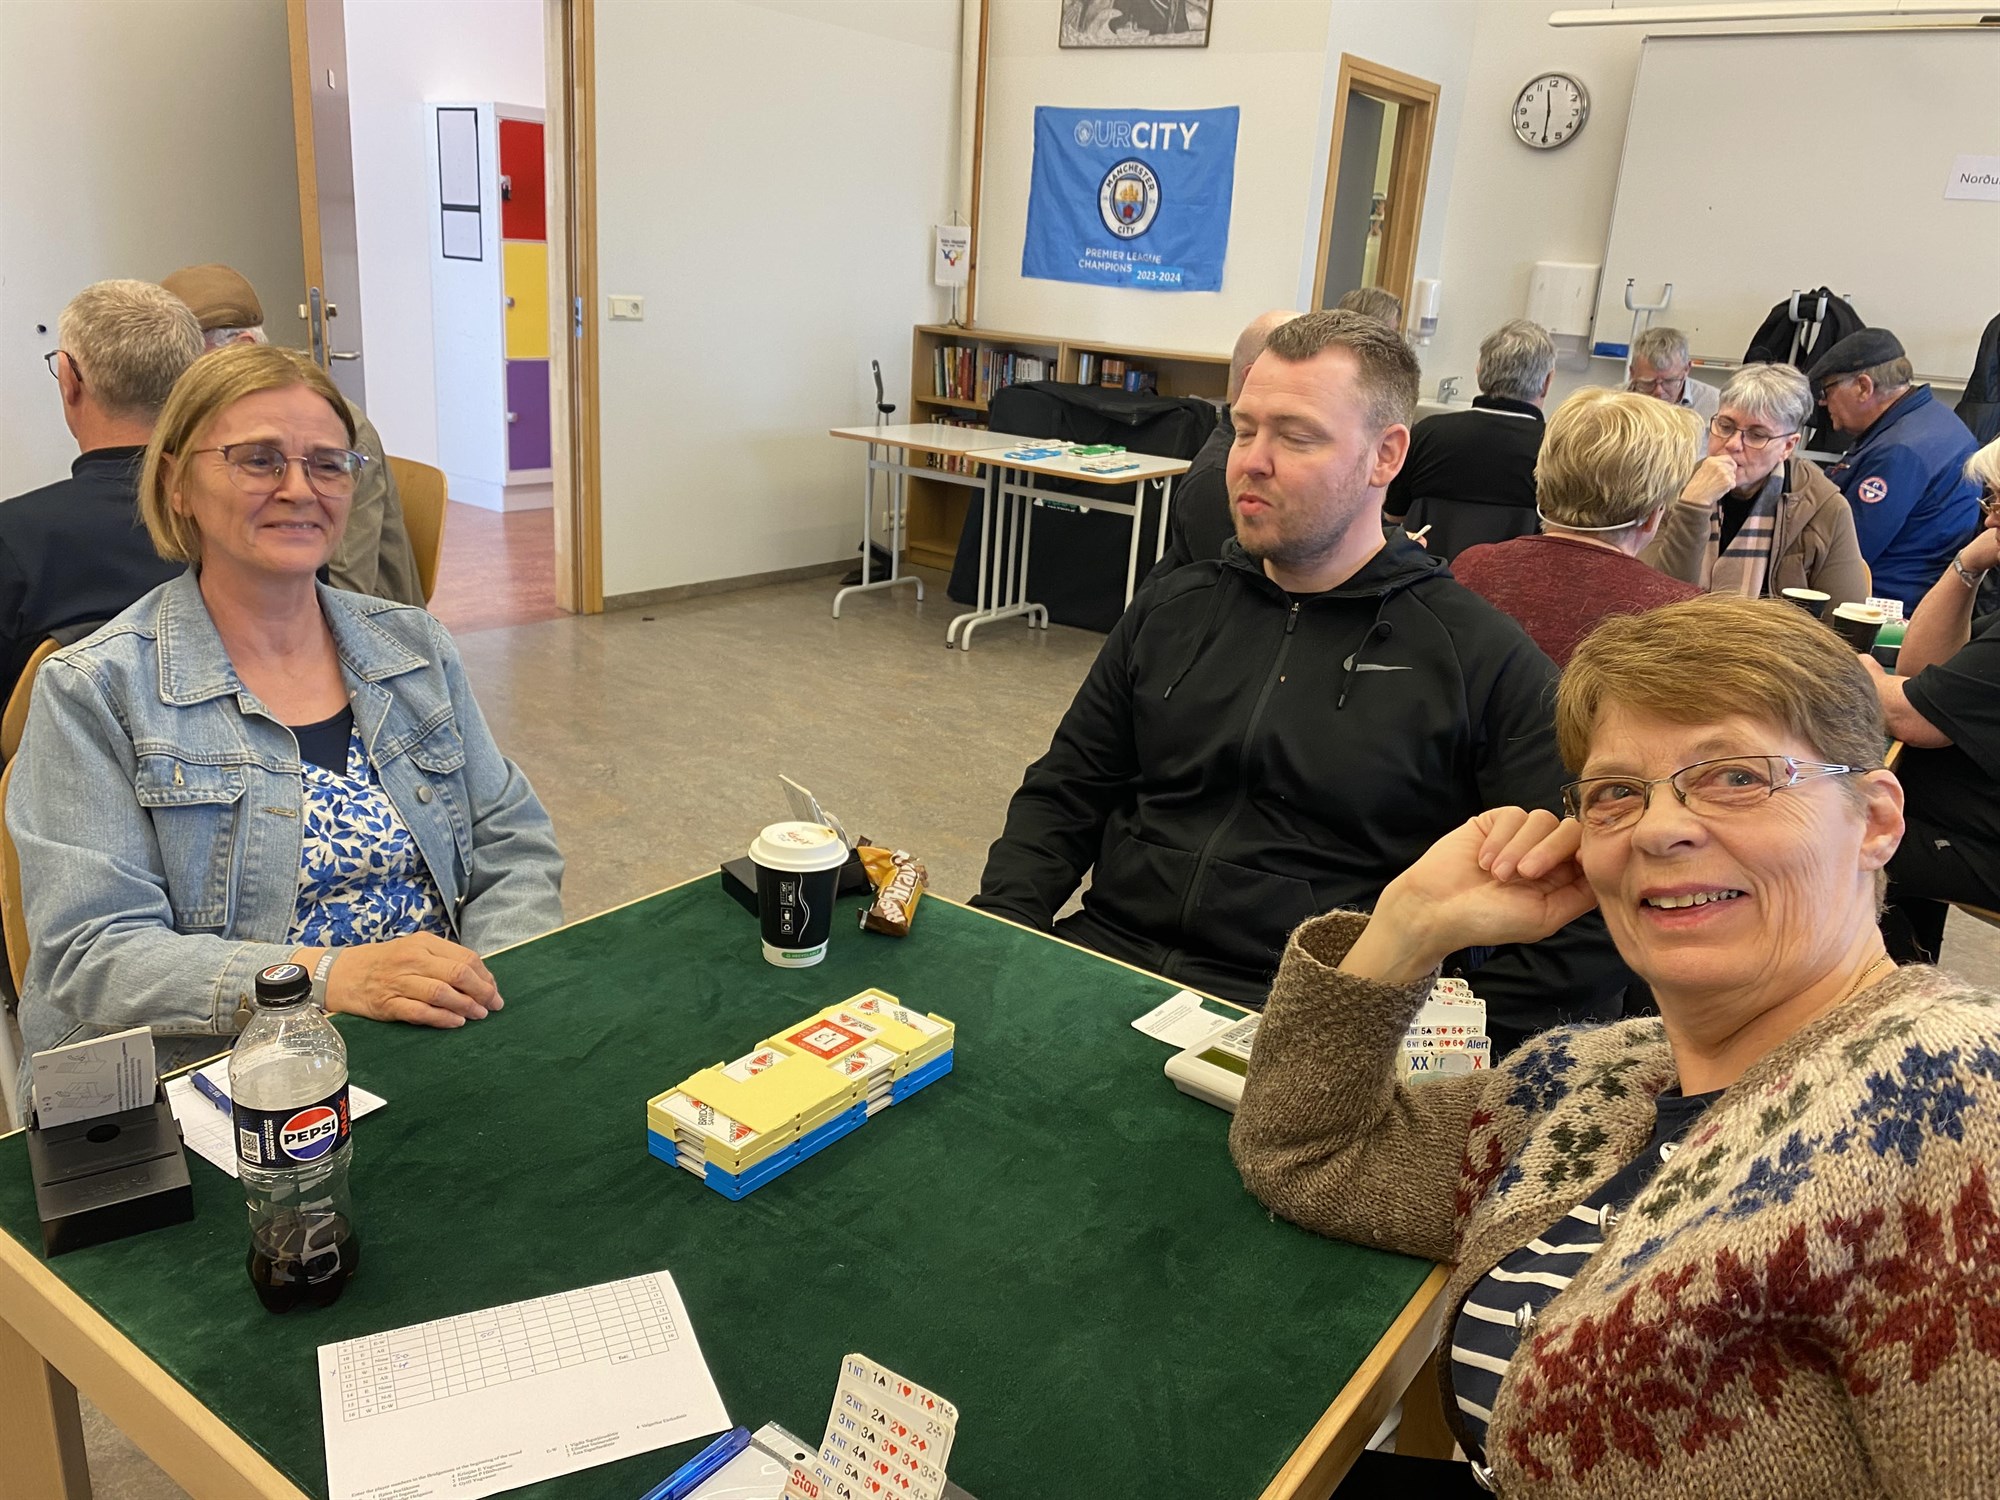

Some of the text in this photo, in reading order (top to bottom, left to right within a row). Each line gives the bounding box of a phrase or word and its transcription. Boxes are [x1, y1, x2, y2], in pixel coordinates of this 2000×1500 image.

[1537, 84, 1542, 92] 11
[1550, 80, 1559, 88] 12
[1526, 94, 1533, 102] 10
[1570, 94, 1577, 102] 2
[1522, 121, 1529, 129] 8
[1566, 121, 1572, 129] 4
[1105, 163, 1155, 192] MANCHESTER
[1960, 173, 2000, 185] Norðu
[1117, 226, 1135, 234] CITY
[1085, 247, 1161, 264] PREMIER LEAGUE
[1078, 259, 1181, 283] CHAMPIONS 2023-2024
[269, 966, 292, 979] PEPSI
[1421, 1027, 1426, 1035] 5
[1407, 1040, 1411, 1048] 6
[1467, 1040, 1488, 1049] Alert
[1411, 1056, 1429, 1070] XX
[1473, 1056, 1482, 1069] X
[339, 1096, 348, 1137] MAX
[698, 1103, 708, 1126] BRIDG
[284, 1118, 335, 1145] PEPSI
[848, 1361, 944, 1414] 1 NT 1 1 1 1
[846, 1395, 919, 1447] 2 NT 2 2 2
[926, 1421, 934, 1434] 2
[838, 1413, 928, 1477] 3 NT 3 3 3 3
[823, 1449, 831, 1461] 5
[830, 1455, 840, 1468] NT
[844, 1463, 852, 1476] 5
[864, 1476, 872, 1489] 5
[830, 1432, 920, 1499] 4 NT 4 4 4 4
[791, 1469, 819, 1498] Stop
[823, 1474, 832, 1487] NT
[837, 1482, 844, 1495] 6
